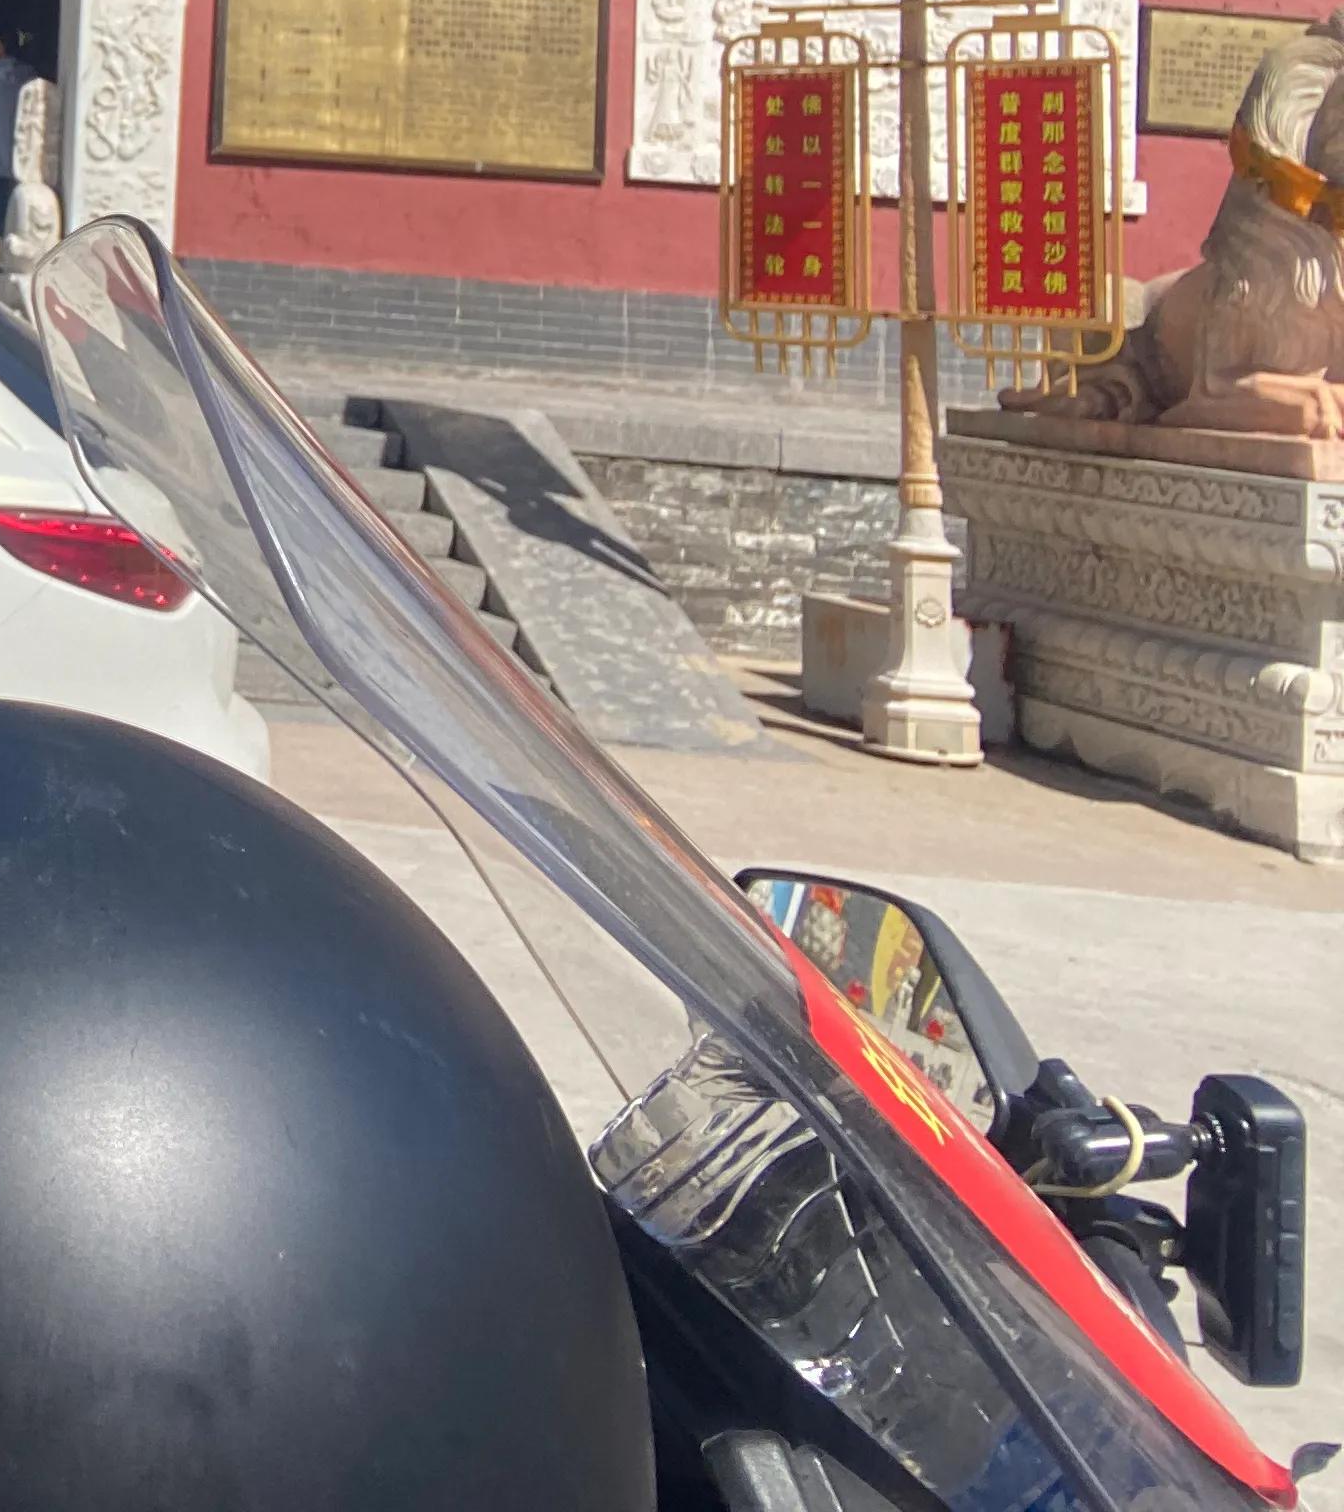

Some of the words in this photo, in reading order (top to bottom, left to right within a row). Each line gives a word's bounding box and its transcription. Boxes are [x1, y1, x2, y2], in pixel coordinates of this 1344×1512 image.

[764, 94, 785, 277] 处处转法轮
[801, 94, 823, 278] 佛以一一身
[1041, 90, 1068, 296] 刹那念尽恒沙佛
